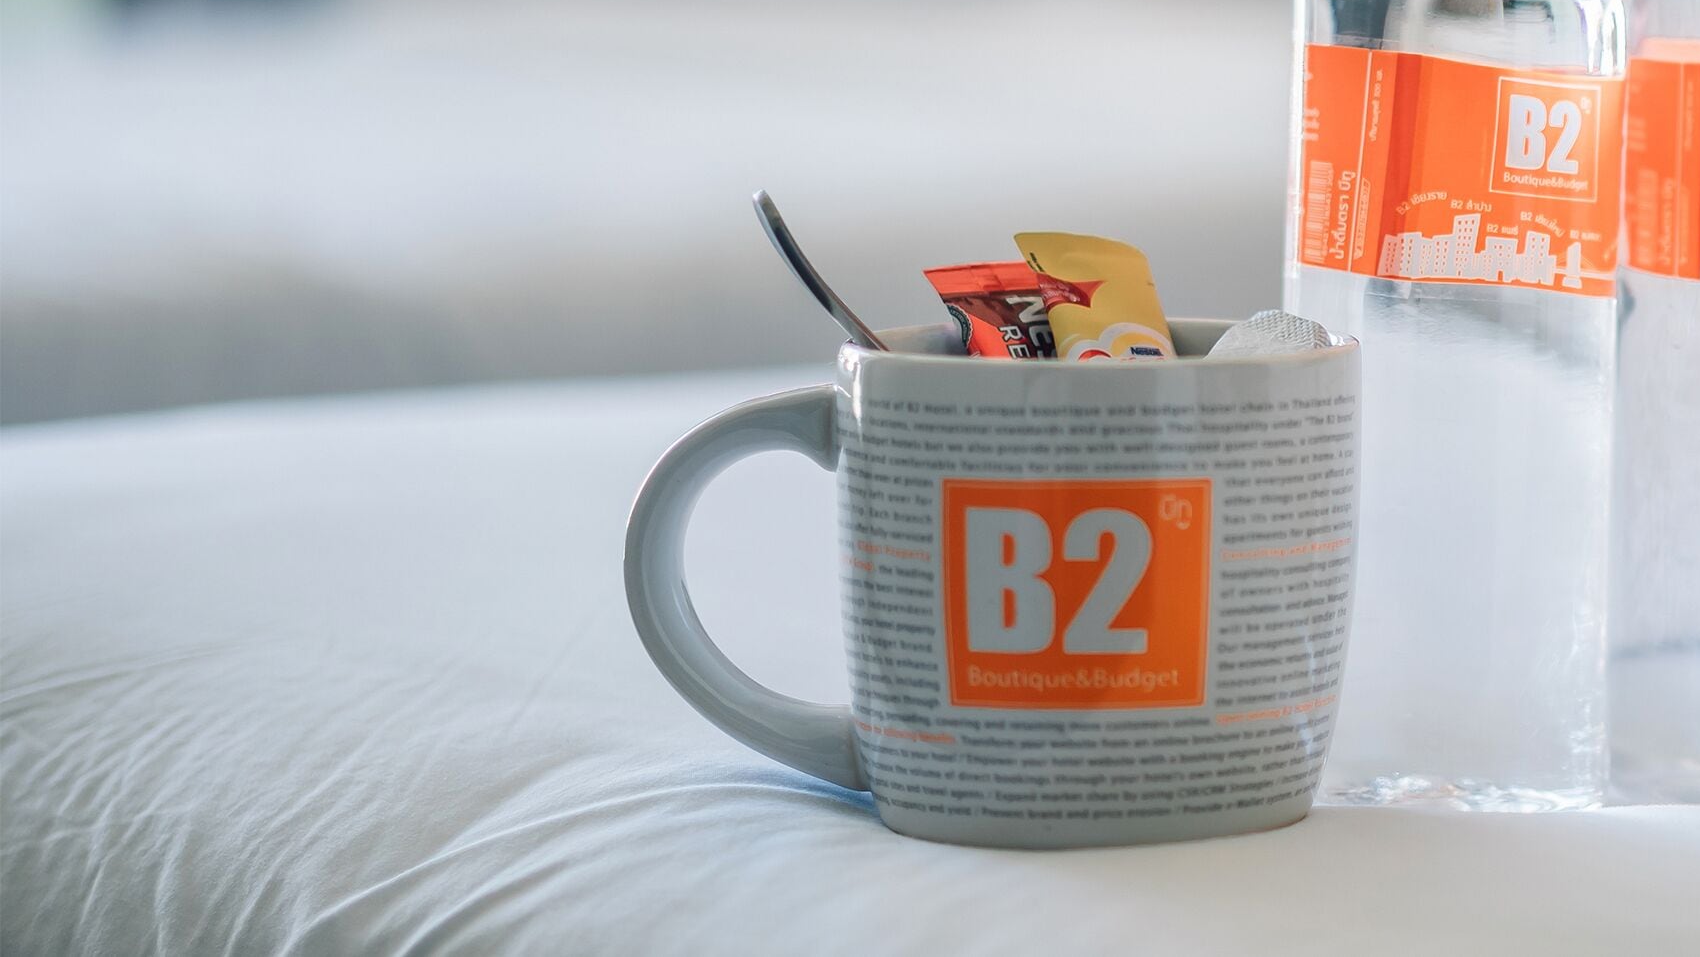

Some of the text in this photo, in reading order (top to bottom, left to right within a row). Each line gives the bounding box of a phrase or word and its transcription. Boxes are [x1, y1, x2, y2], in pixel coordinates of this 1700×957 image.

[1505, 94, 1582, 175] B2
[1450, 198, 1463, 210] B2
[1520, 211, 1533, 222] B2
[1486, 224, 1499, 235] B2
[965, 507, 1153, 655] B2
[968, 663, 1179, 693] Boutique&Budget
